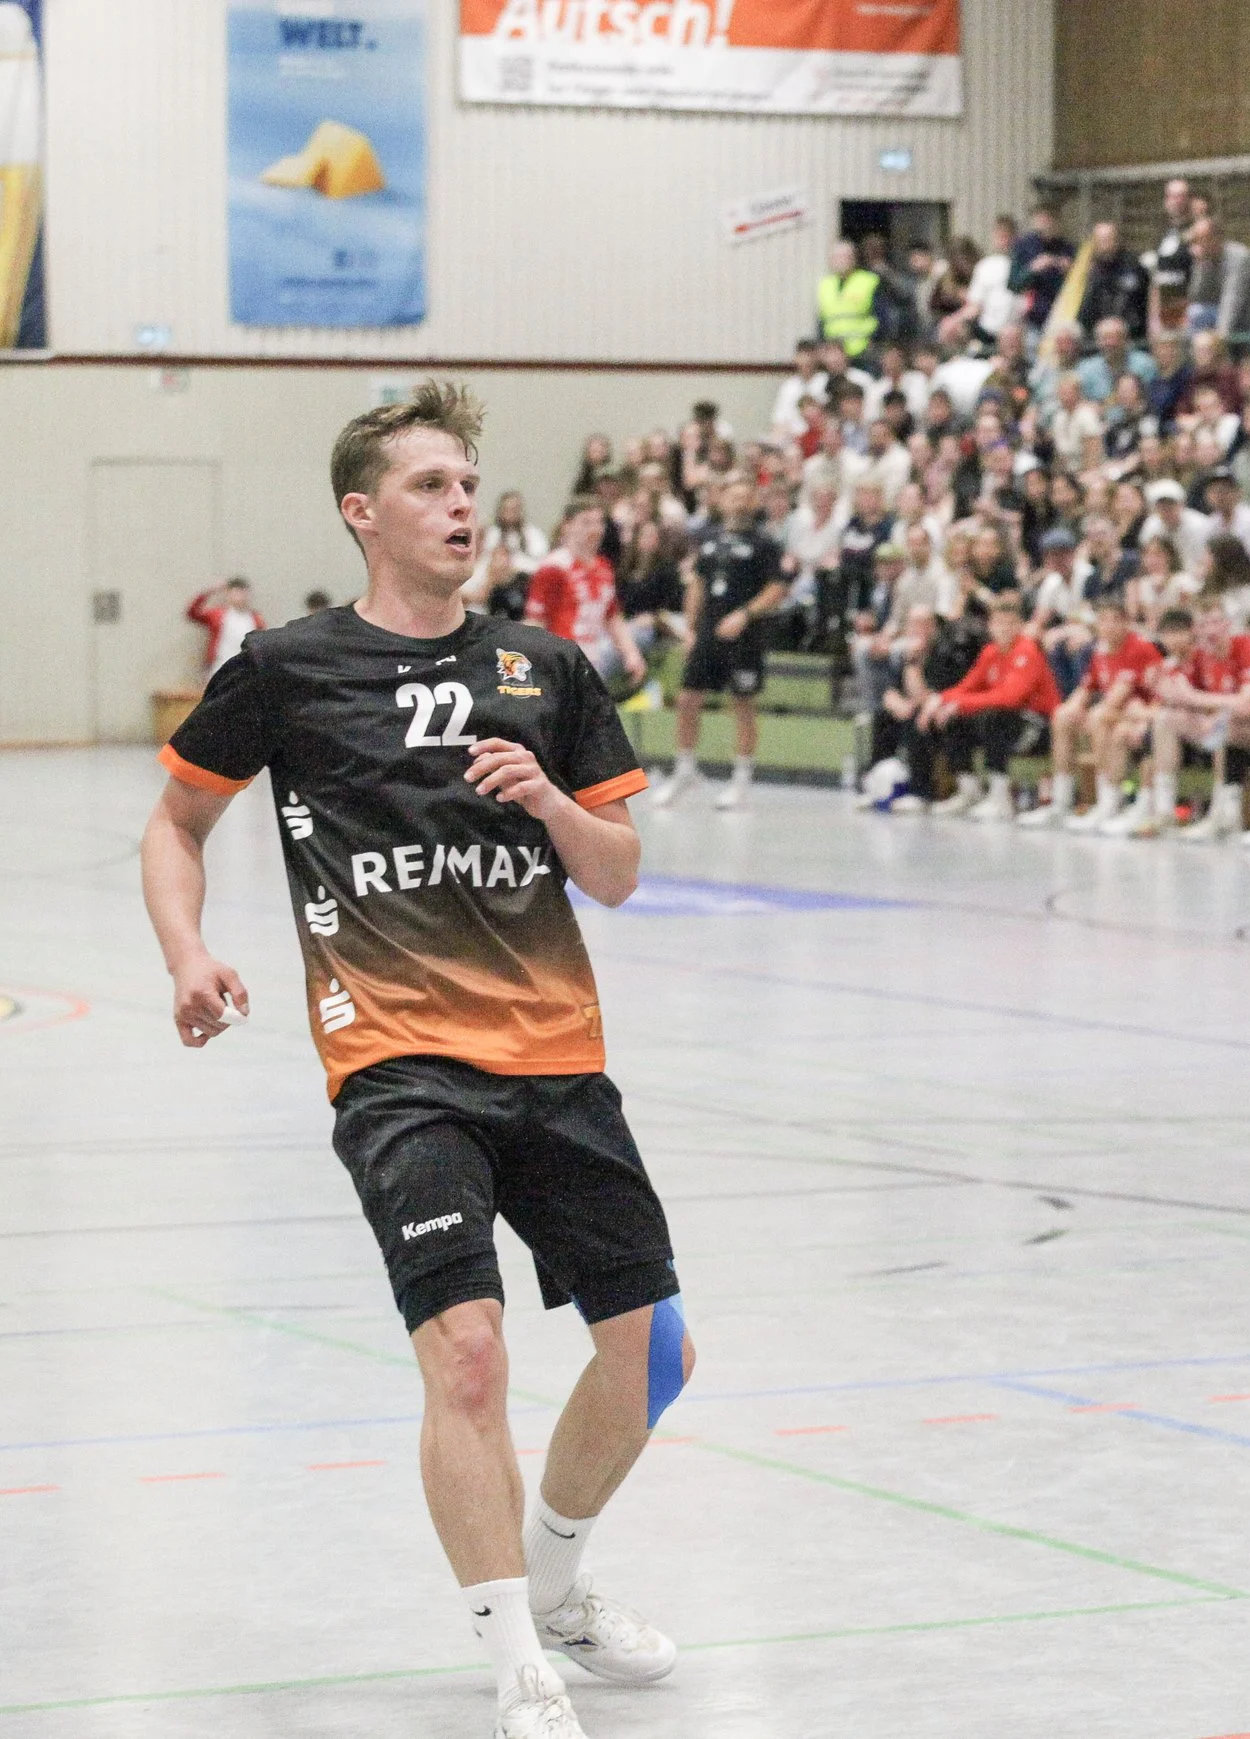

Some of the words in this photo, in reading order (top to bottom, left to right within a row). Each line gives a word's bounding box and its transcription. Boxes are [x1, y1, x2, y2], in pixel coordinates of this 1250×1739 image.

[395, 681, 478, 748] 22
[351, 843, 551, 898] RE/MAX
[401, 1211, 463, 1241] Kempa
